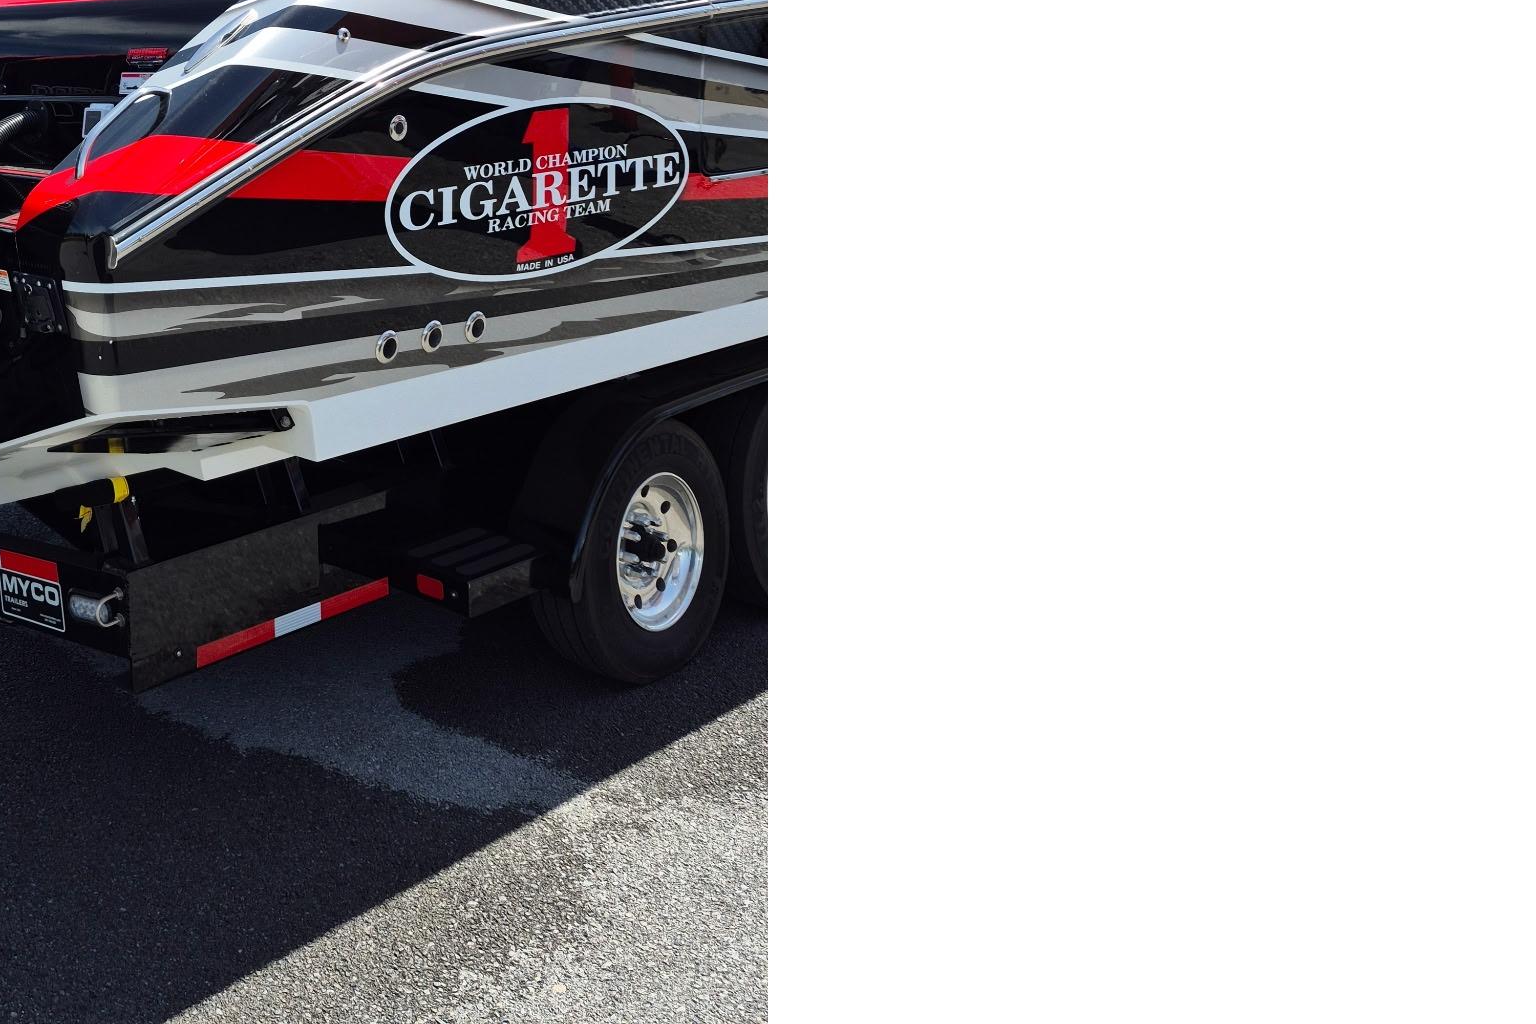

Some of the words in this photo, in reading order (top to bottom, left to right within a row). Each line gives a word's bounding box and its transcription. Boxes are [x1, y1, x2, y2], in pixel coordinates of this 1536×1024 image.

[464, 157, 532, 181] WORLD
[535, 143, 629, 171] CHAMPION
[399, 151, 681, 231] CIGARETTE
[487, 207, 560, 234] RACING
[563, 198, 611, 220] TEAM
[516, 261, 541, 272] MADE
[545, 259, 553, 268] IN
[557, 254, 574, 265] USA
[1, 573, 60, 607] MYCO
[4, 594, 28, 608] TRAILERS
